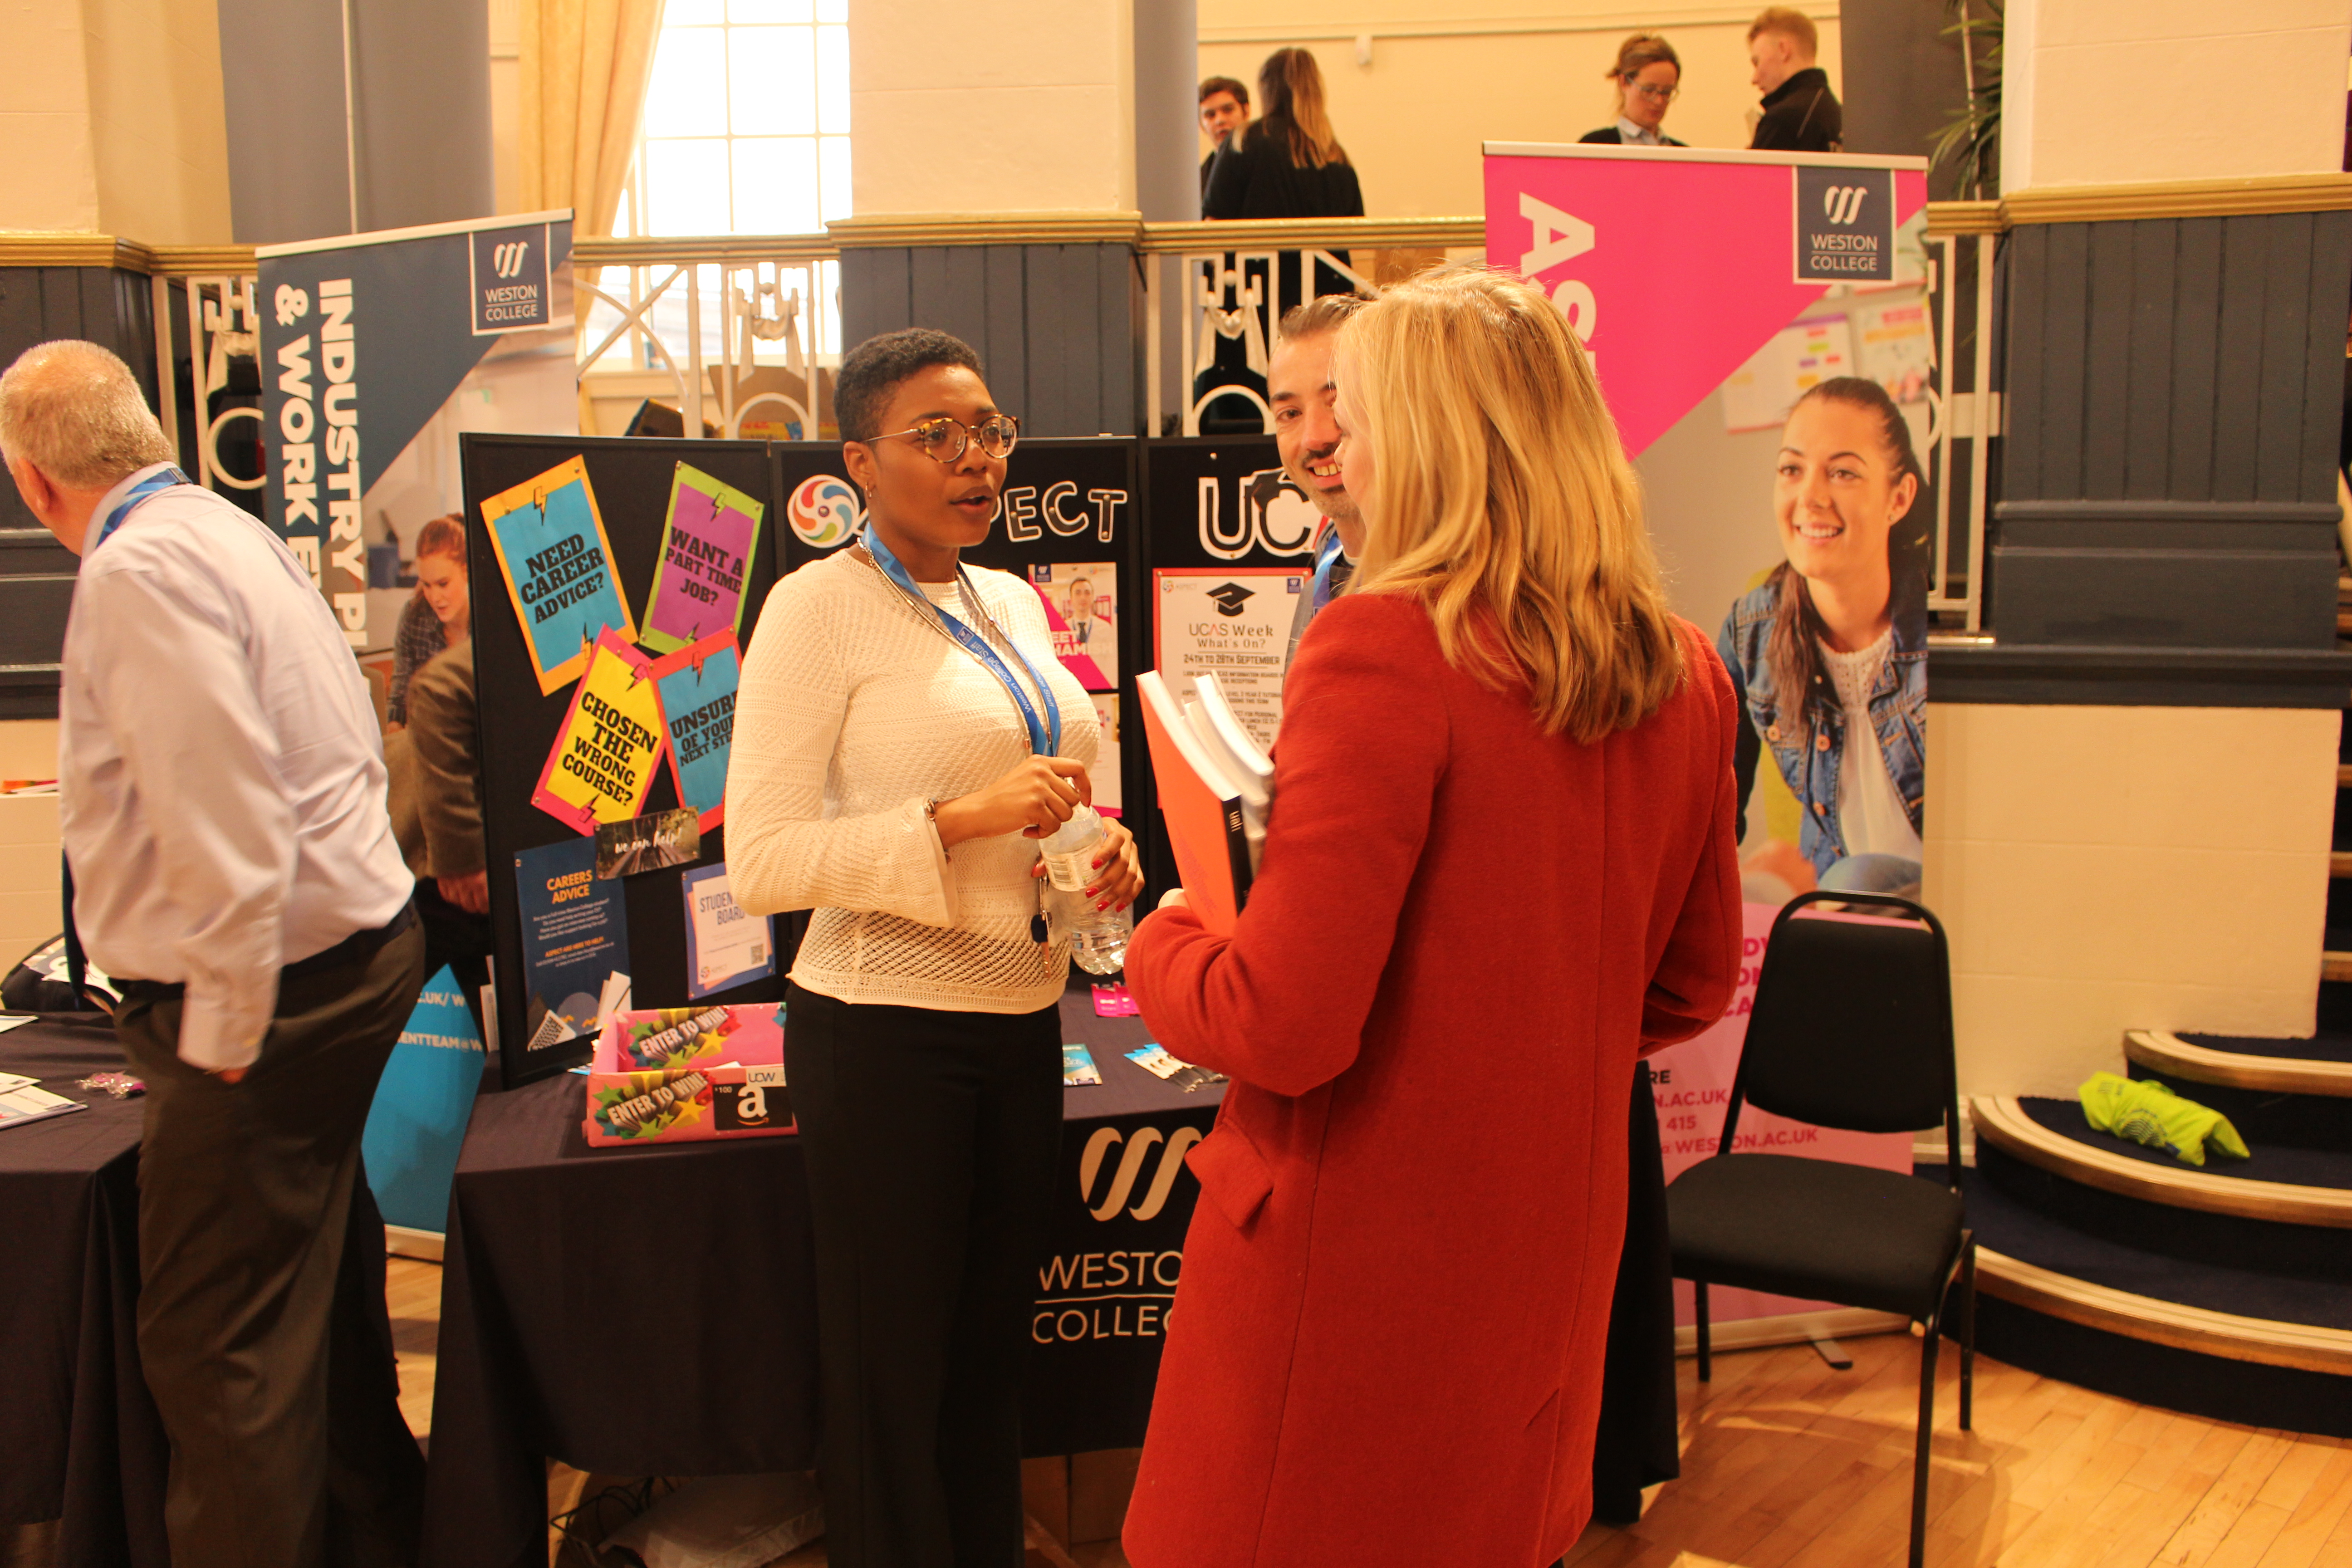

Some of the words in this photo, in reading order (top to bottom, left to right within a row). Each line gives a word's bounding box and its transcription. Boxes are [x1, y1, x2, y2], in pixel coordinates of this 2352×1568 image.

[1811, 234, 1878, 251] WESTON
[1810, 255, 1877, 271] COLLEGE
[274, 284, 309, 326] &
[485, 284, 538, 303] WESTON
[485, 304, 538, 322] COLLEGE
[278, 334, 318, 526] WORK
[319, 278, 364, 581] INDUSTRY
[990, 480, 1128, 543] ECT
[287, 535, 322, 590] E
[525, 534, 584, 578] NEED
[670, 526, 729, 563] WANT
[731, 557, 745, 578] A
[521, 547, 605, 604] CAREER
[665, 546, 704, 574] PART
[706, 567, 743, 594] TIME
[535, 572, 605, 623] ADVICE?
[680, 578, 720, 606] JOB?
[1189, 622, 1228, 636] UCAS
[1232, 624, 1274, 636] Week
[1197, 638, 1239, 648] What's
[1243, 638, 1266, 648] On?
[970, 640, 989, 659] Staff
[1205, 655, 1215, 664] TO
[1235, 655, 1280, 665] SEPTEMBER
[987, 656, 1012, 682] College
[1011, 682, 1031, 713] Weston
[1044, 689, 1055, 708] Staff
[581, 691, 657, 753] CHOSEN
[681, 733, 699, 752] OF
[701, 714, 734, 741] YOU
[593, 723, 634, 764] THE
[679, 742, 710, 767] NEXT
[575, 736, 635, 786] WRONG
[563, 754, 633, 806] COURSE?
[615, 843, 628, 854] we
[631, 838, 652, 851] can
[653, 827, 682, 848] help!
[547, 870, 593, 892] CAREERS
[551, 887, 590, 904] ADVICE
[700, 892, 733, 913] STUDEN
[717, 906, 745, 926] BOARD
[416, 991, 449, 1007] .UK/
[638, 1027, 684, 1055] ENTER
[678, 1019, 699, 1038] TO
[695, 1006, 729, 1029] WIN!
[749, 1072, 775, 1083] UCW
[607, 1094, 657, 1125] ENTER
[651, 1087, 675, 1106] TO
[670, 1071, 709, 1096] WIN!
[1666, 1115, 1697, 1131] 415
[1032, 1306, 1172, 1344] COLLE
